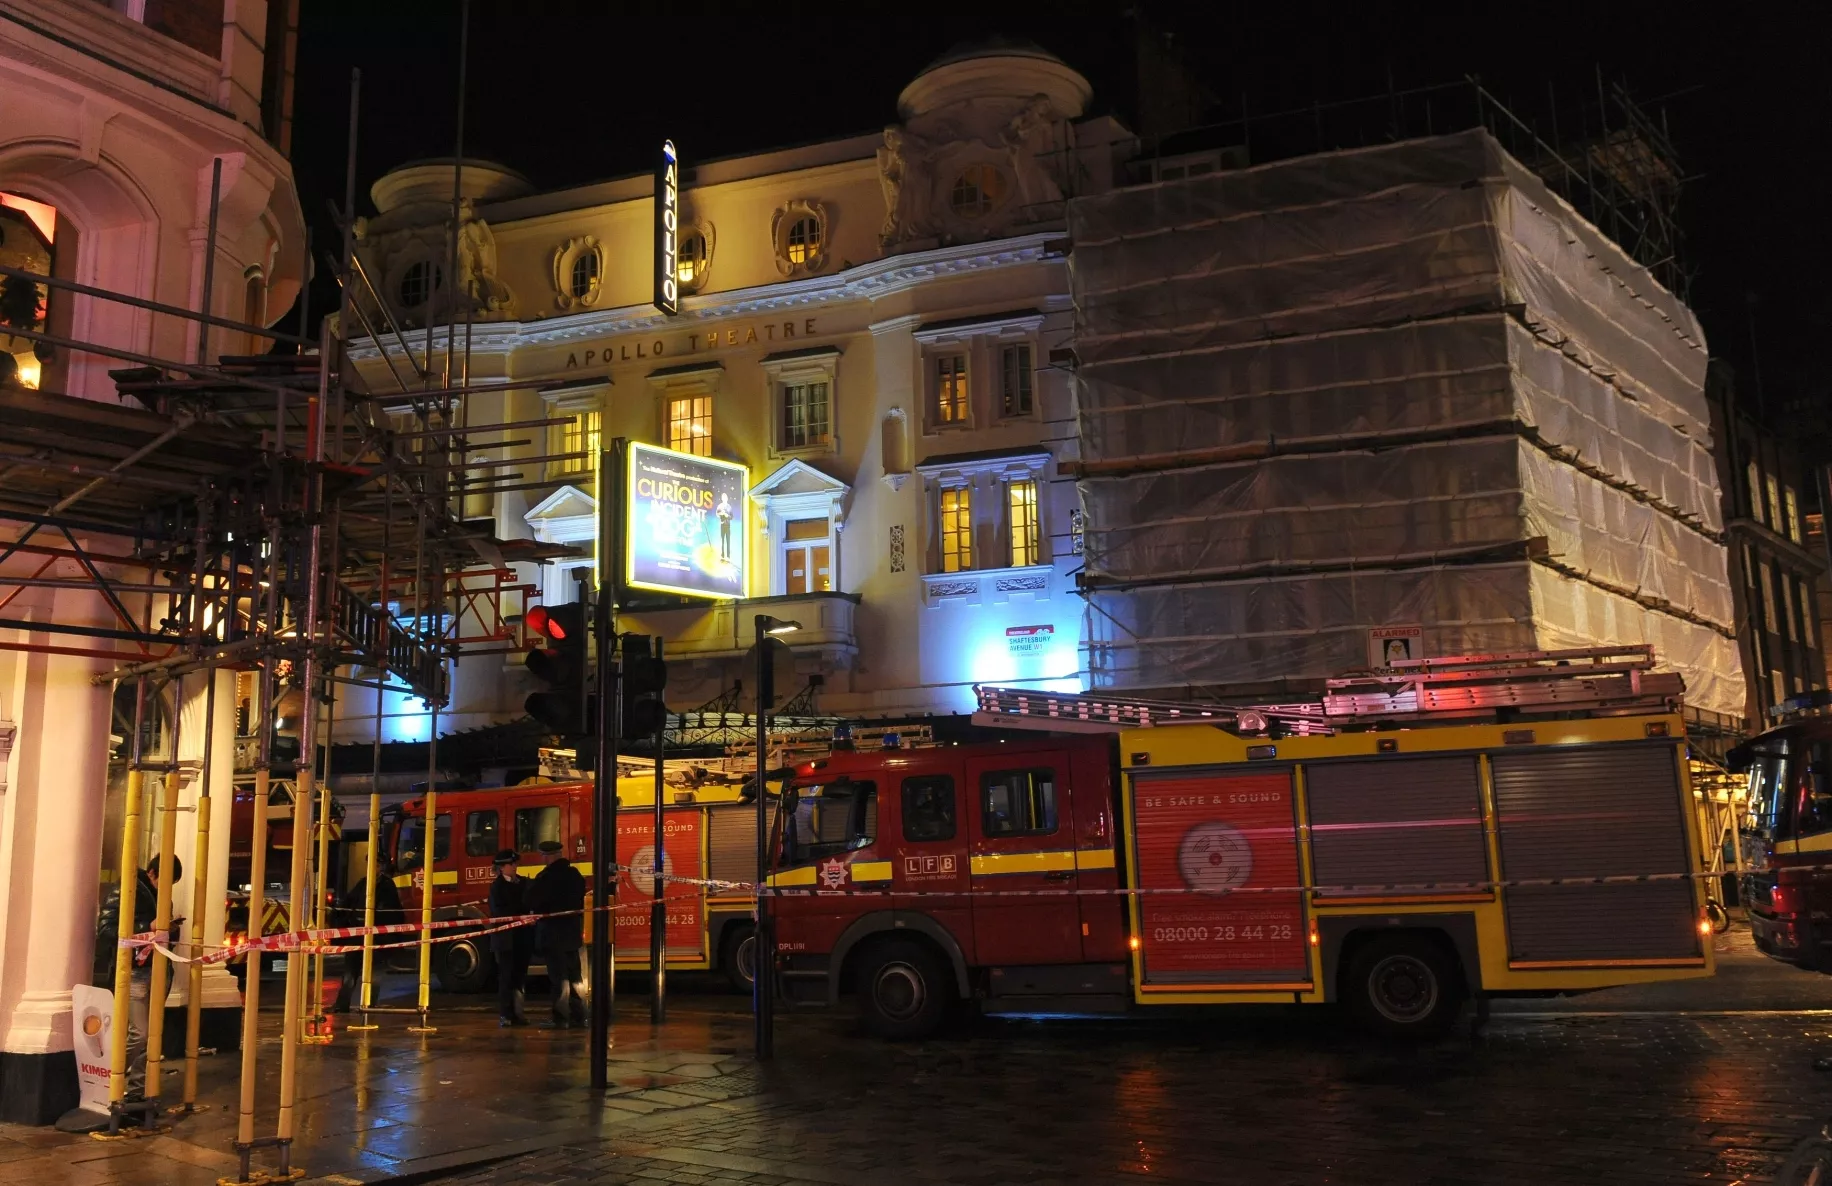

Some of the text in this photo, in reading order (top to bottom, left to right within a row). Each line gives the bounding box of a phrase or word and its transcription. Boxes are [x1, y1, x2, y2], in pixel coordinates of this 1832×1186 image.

[664, 164, 676, 302] APOLLO
[566, 318, 817, 368] APOLLO THEATRE
[638, 478, 713, 509] CURIOUS
[651, 499, 707, 521] INCIDENT
[1009, 636, 1051, 645] SHAFTESBURY
[1372, 628, 1420, 638] ALARMED
[1010, 643, 1032, 652] AVENUE
[1145, 792, 1281, 808] BE SAFE & SOUND
[626, 826, 648, 834] SAFE
[662, 824, 693, 833] SOUND
[908, 856, 954, 872] LFB
[681, 914, 694, 925] 28
[1154, 924, 1292, 941] 08000 28 44 28
